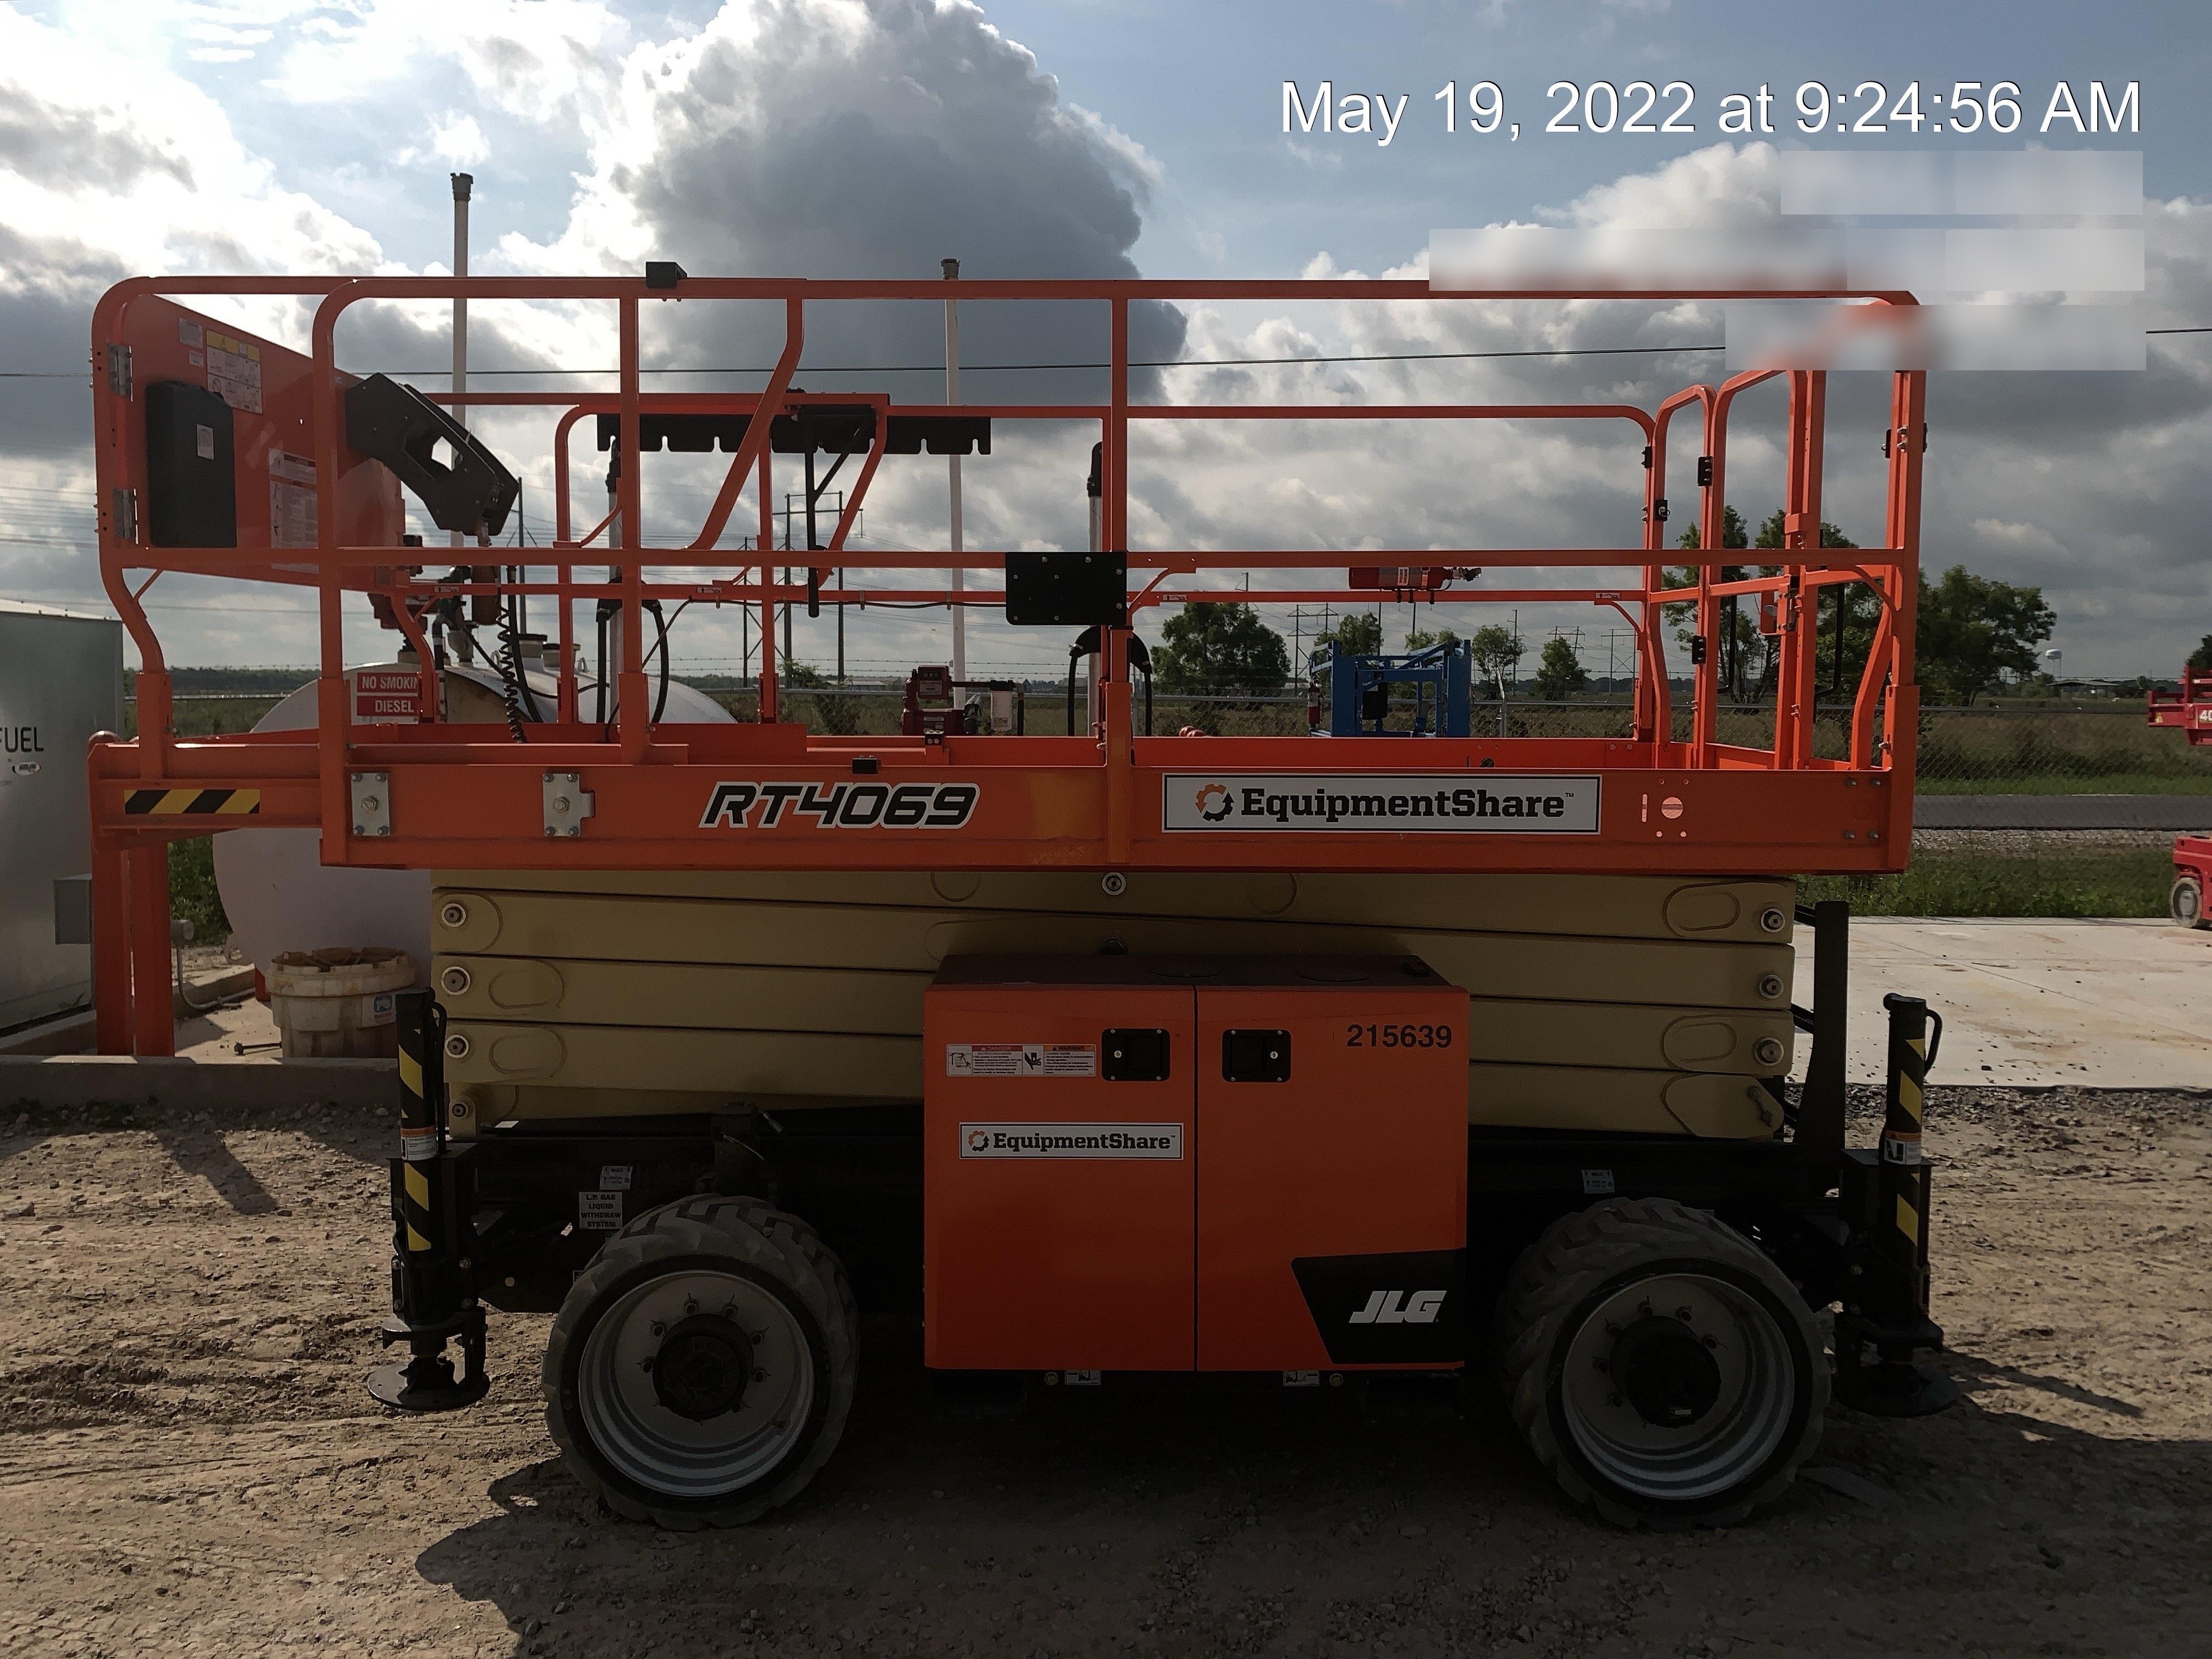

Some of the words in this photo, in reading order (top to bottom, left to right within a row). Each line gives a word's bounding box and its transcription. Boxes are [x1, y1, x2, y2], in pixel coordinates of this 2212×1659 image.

[362, 675, 377, 689] NO
[375, 699, 415, 713] DIESEL
[0, 727, 44, 752] UEL
[699, 782, 980, 828] RT4069
[1347, 1024, 1452, 1048] 215639
[1348, 1290, 1447, 1324] JLG
